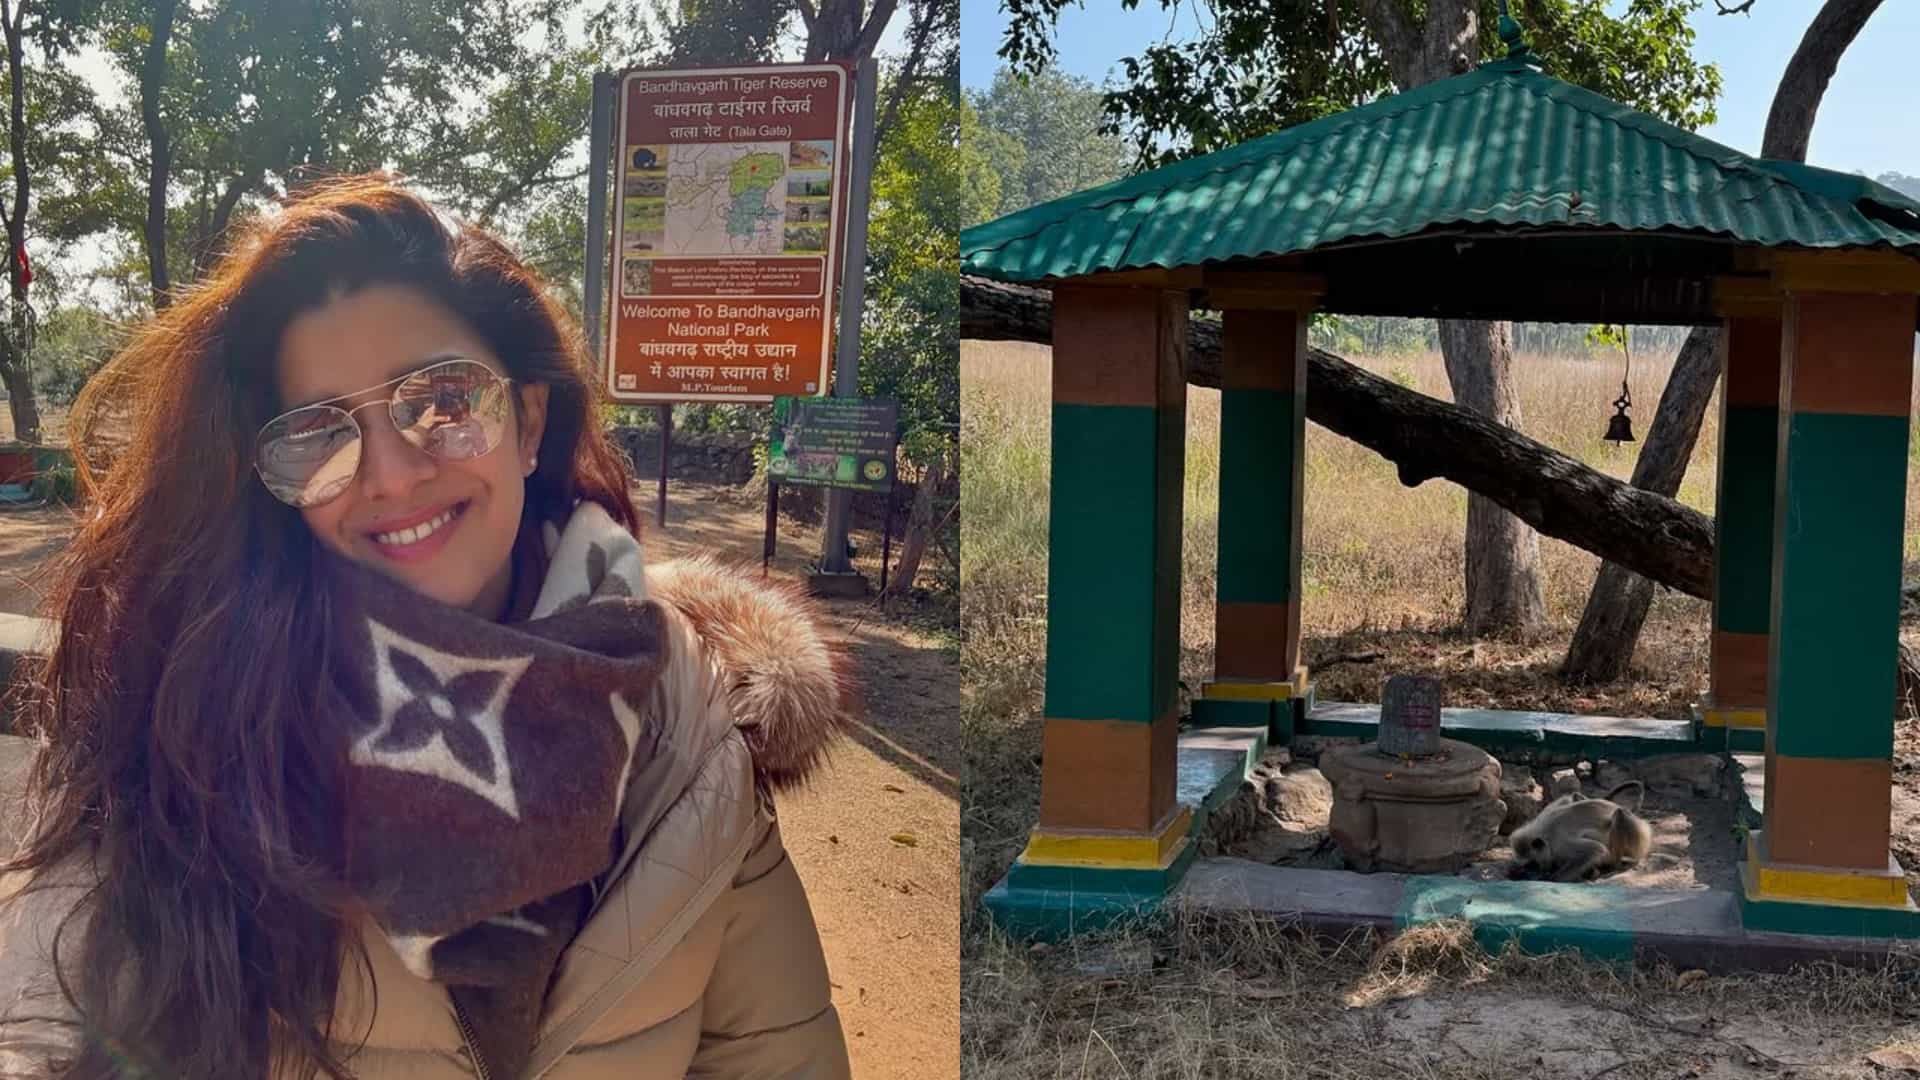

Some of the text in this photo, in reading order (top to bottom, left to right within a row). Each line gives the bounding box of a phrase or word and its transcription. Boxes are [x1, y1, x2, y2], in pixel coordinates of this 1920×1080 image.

[640, 76, 828, 95] Bandhavgarh Tiger Reserve
[718, 96, 766, 118] टाईगर
[771, 95, 813, 116] रिजर्व
[669, 126, 698, 139] ताला
[704, 122, 721, 138] गेट
[759, 125, 792, 138] Gate)
[622, 304, 820, 321] Welcome To Bandhavgarh
[668, 322, 770, 337] National Park
[703, 338, 748, 361] राष्ट्रीय
[755, 343, 797, 359] उद्यान
[649, 361, 661, 379] में
[667, 365, 714, 381] आपका
[720, 365, 767, 381] स्वागत
